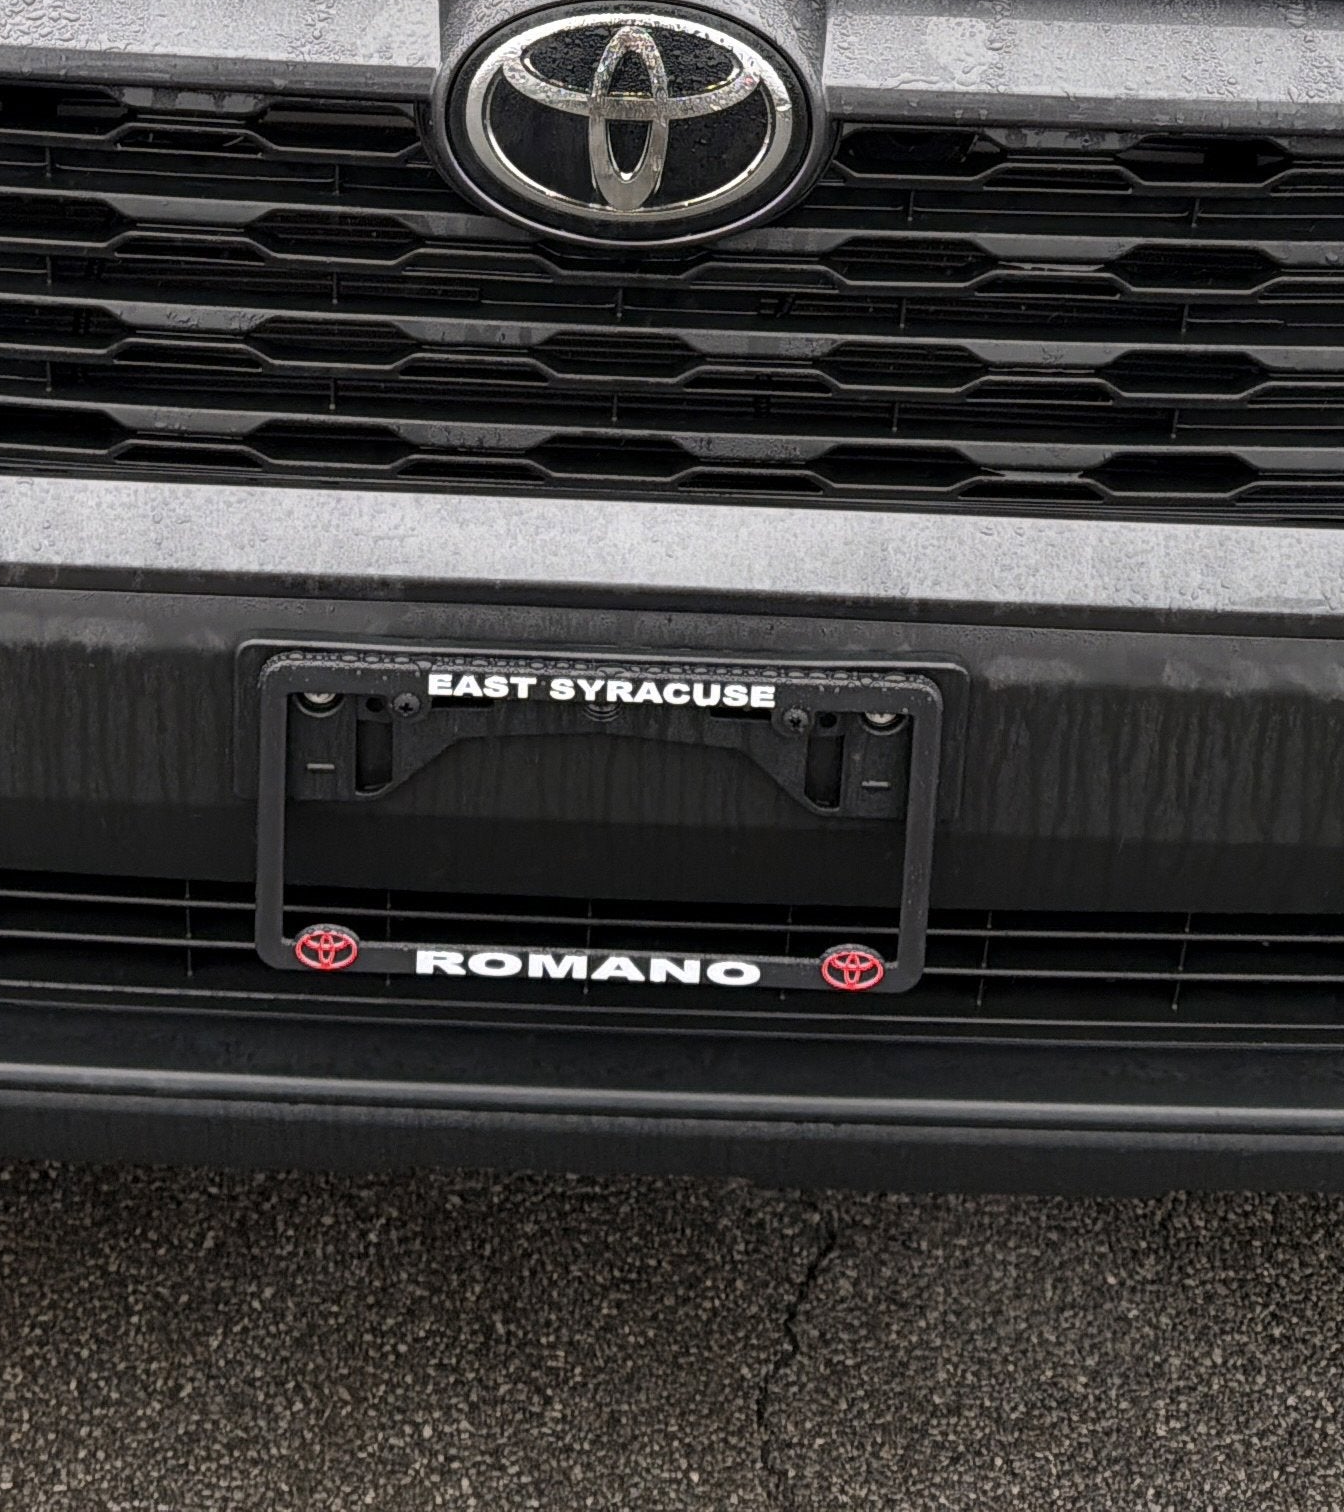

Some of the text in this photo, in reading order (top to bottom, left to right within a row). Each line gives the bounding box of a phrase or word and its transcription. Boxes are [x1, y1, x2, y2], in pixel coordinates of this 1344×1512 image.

[428, 674, 776, 708] EAST SYRACUSE
[415, 950, 761, 986] ROMANO
